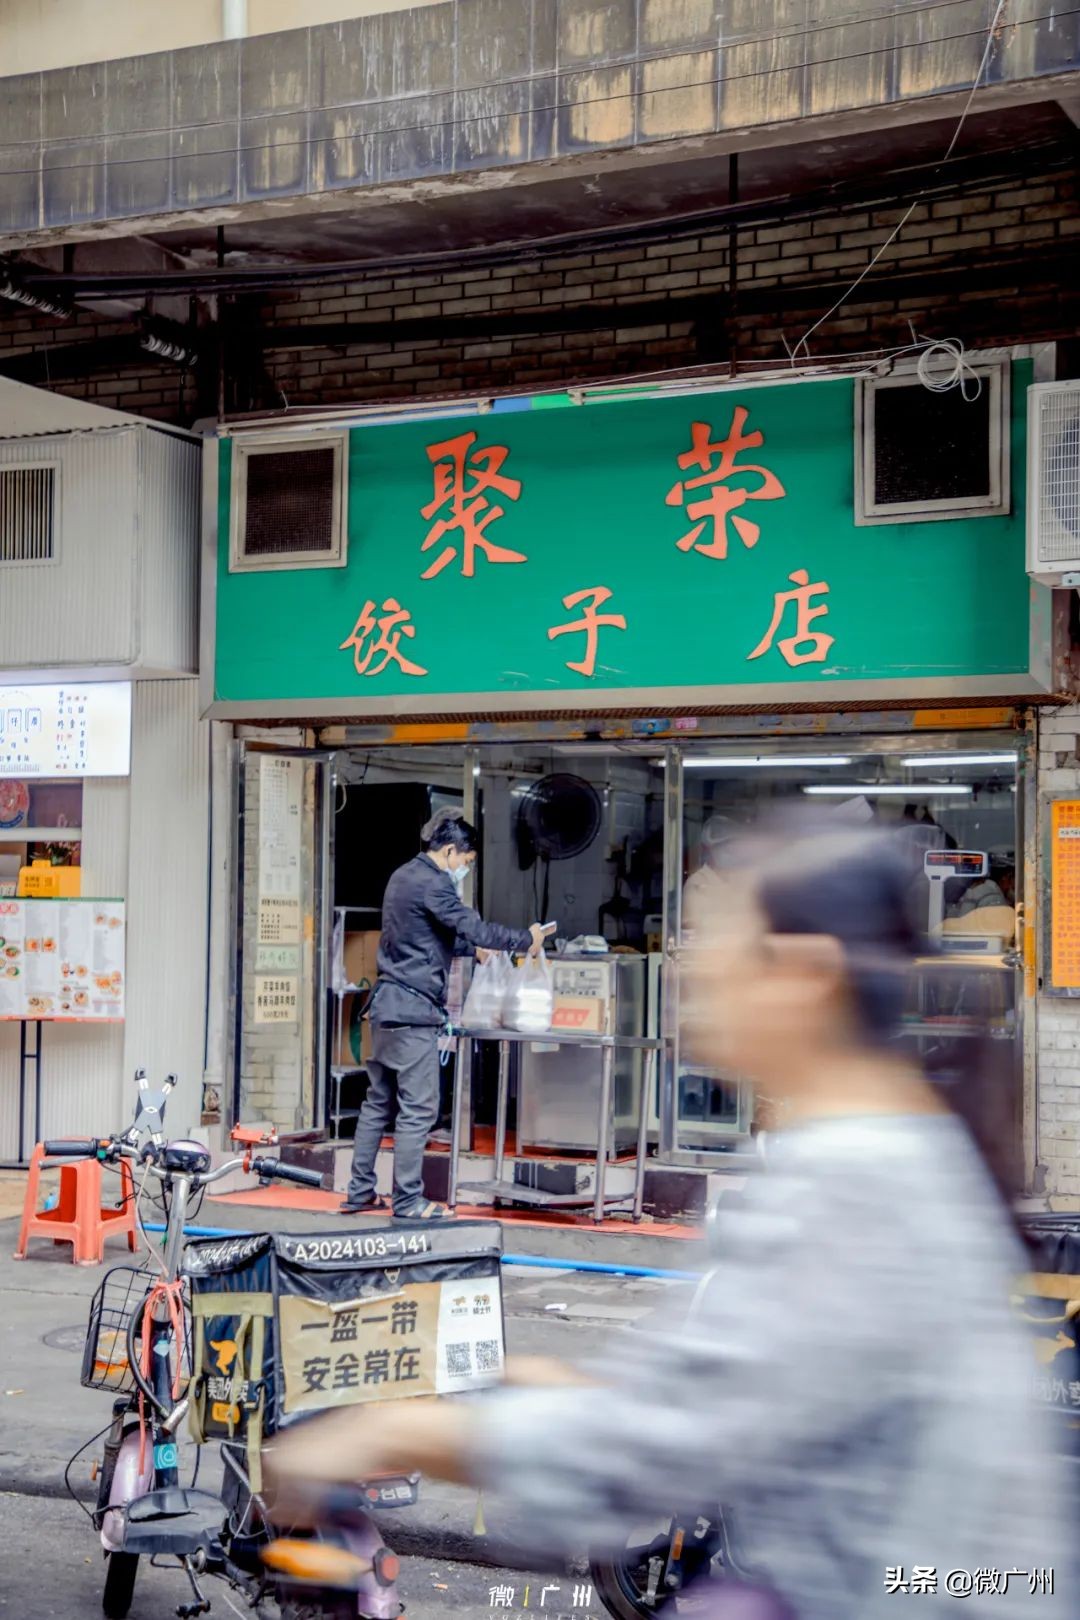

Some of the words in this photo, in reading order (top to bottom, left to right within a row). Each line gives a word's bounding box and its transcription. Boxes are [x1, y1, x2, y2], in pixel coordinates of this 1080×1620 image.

[420, 406, 785, 580] 聚荣
[340, 570, 835, 678] 饺子店
[294, 1234, 428, 1262] A2024103-141
[301, 1300, 418, 1344] 一盔一带
[302, 1346, 421, 1394] 安全常在
